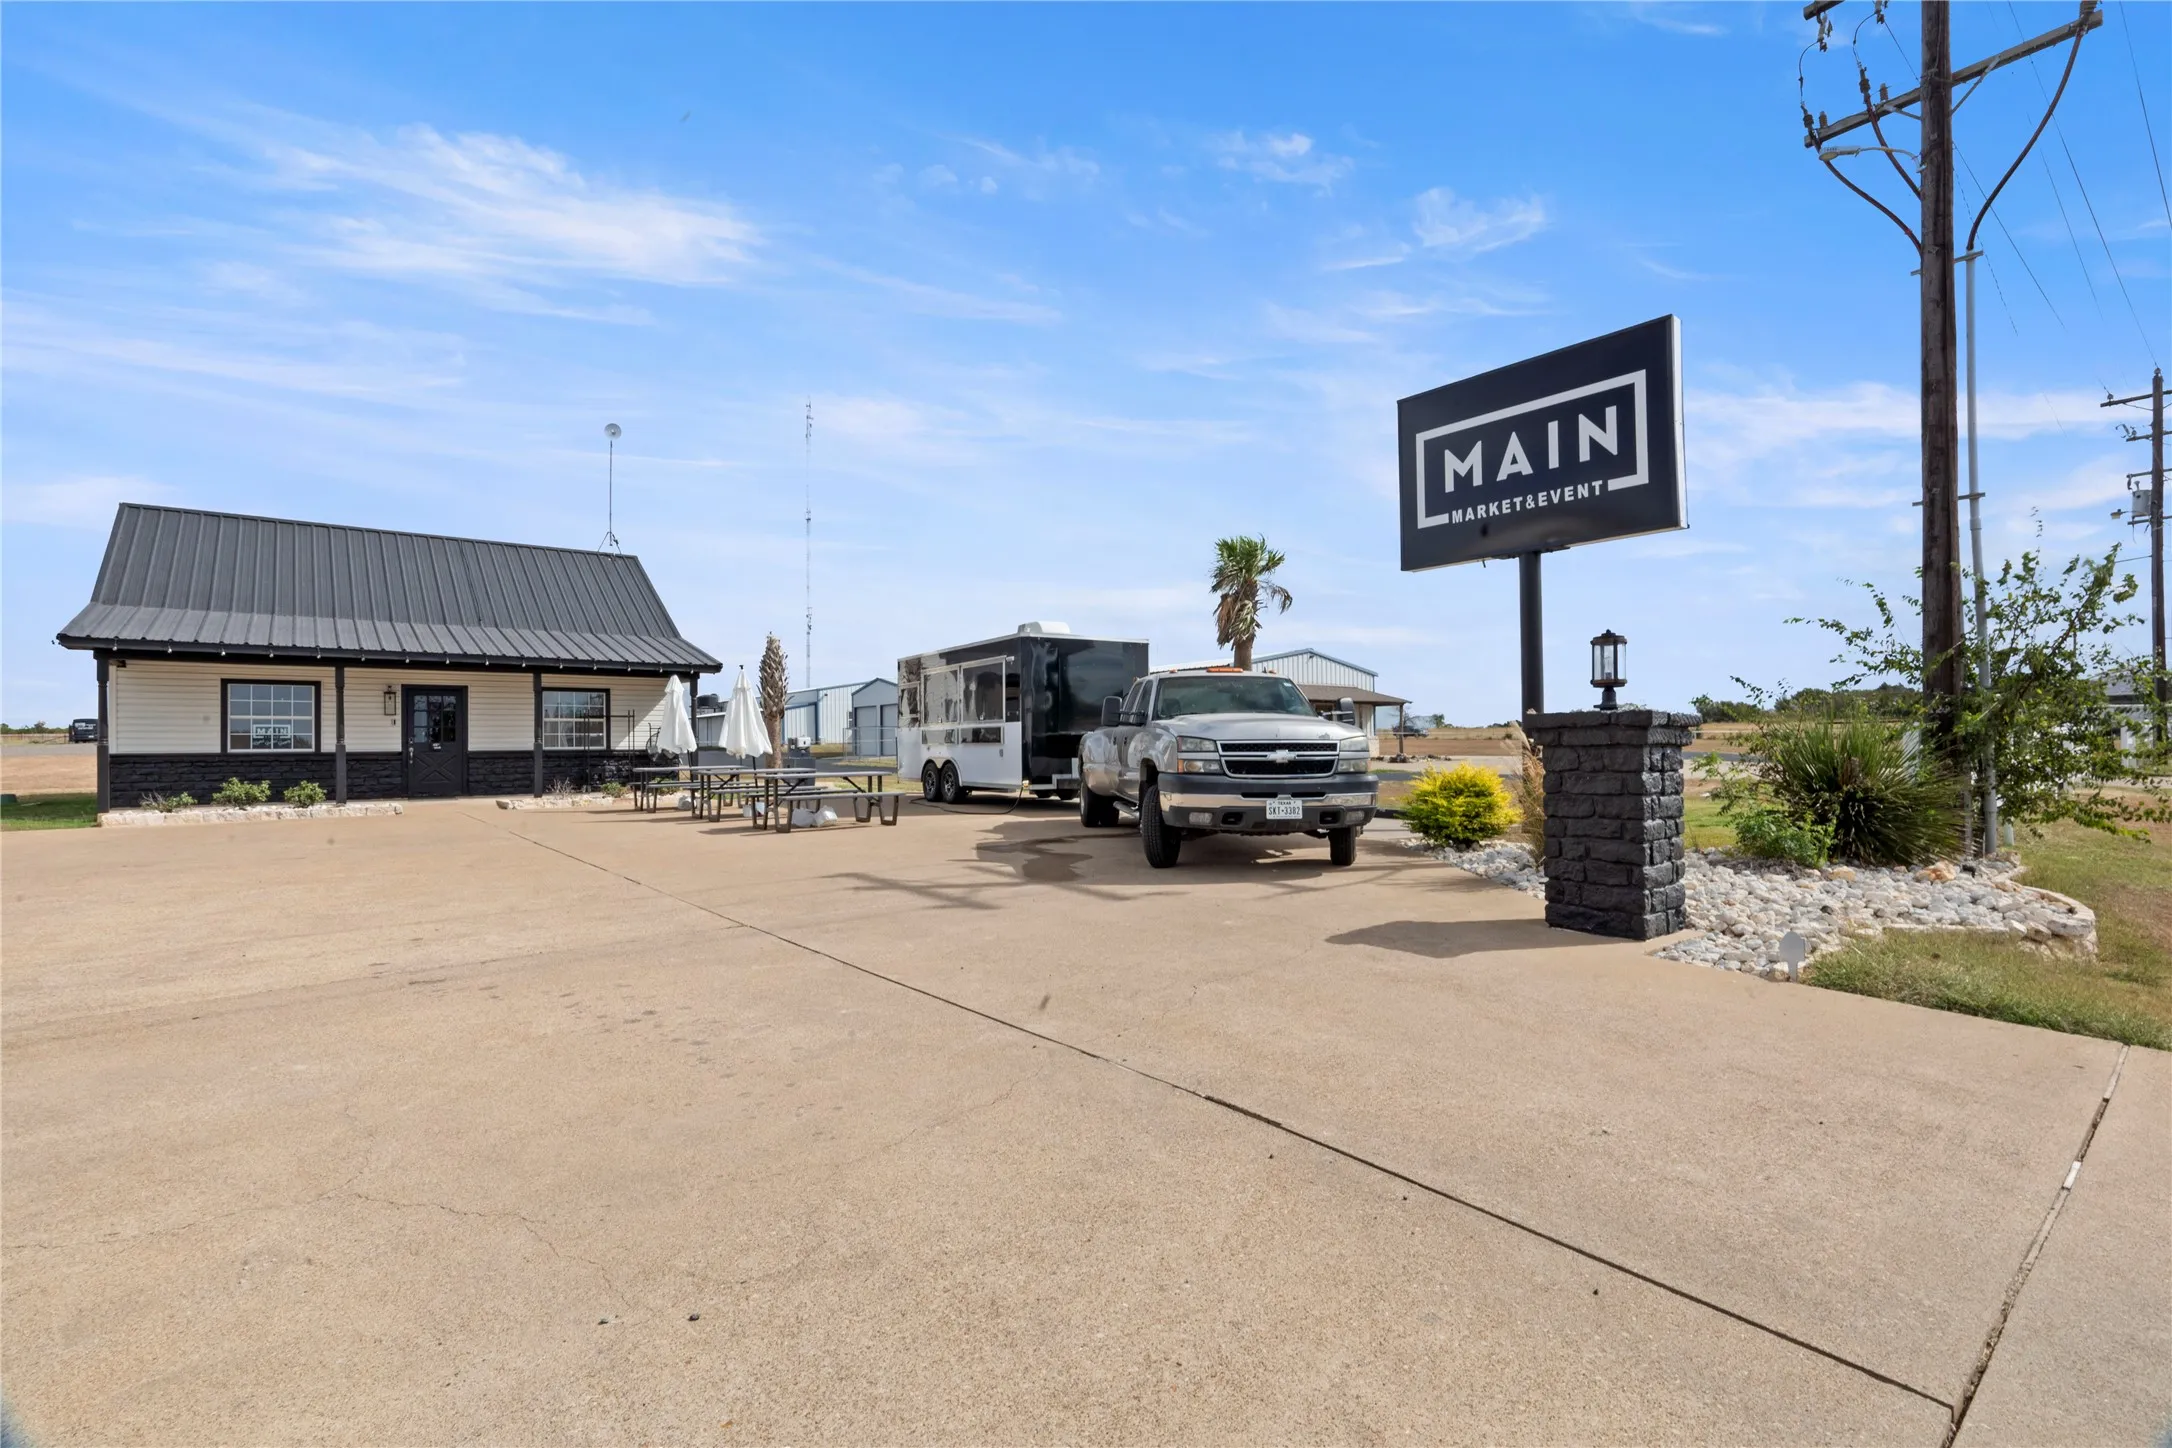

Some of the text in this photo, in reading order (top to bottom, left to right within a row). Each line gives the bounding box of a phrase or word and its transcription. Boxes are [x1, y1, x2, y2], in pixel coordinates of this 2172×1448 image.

[1444, 405, 1618, 493] MAIN
[1452, 480, 1603, 524] MARKET&EVENT
[256, 727, 288, 735] MAIN
